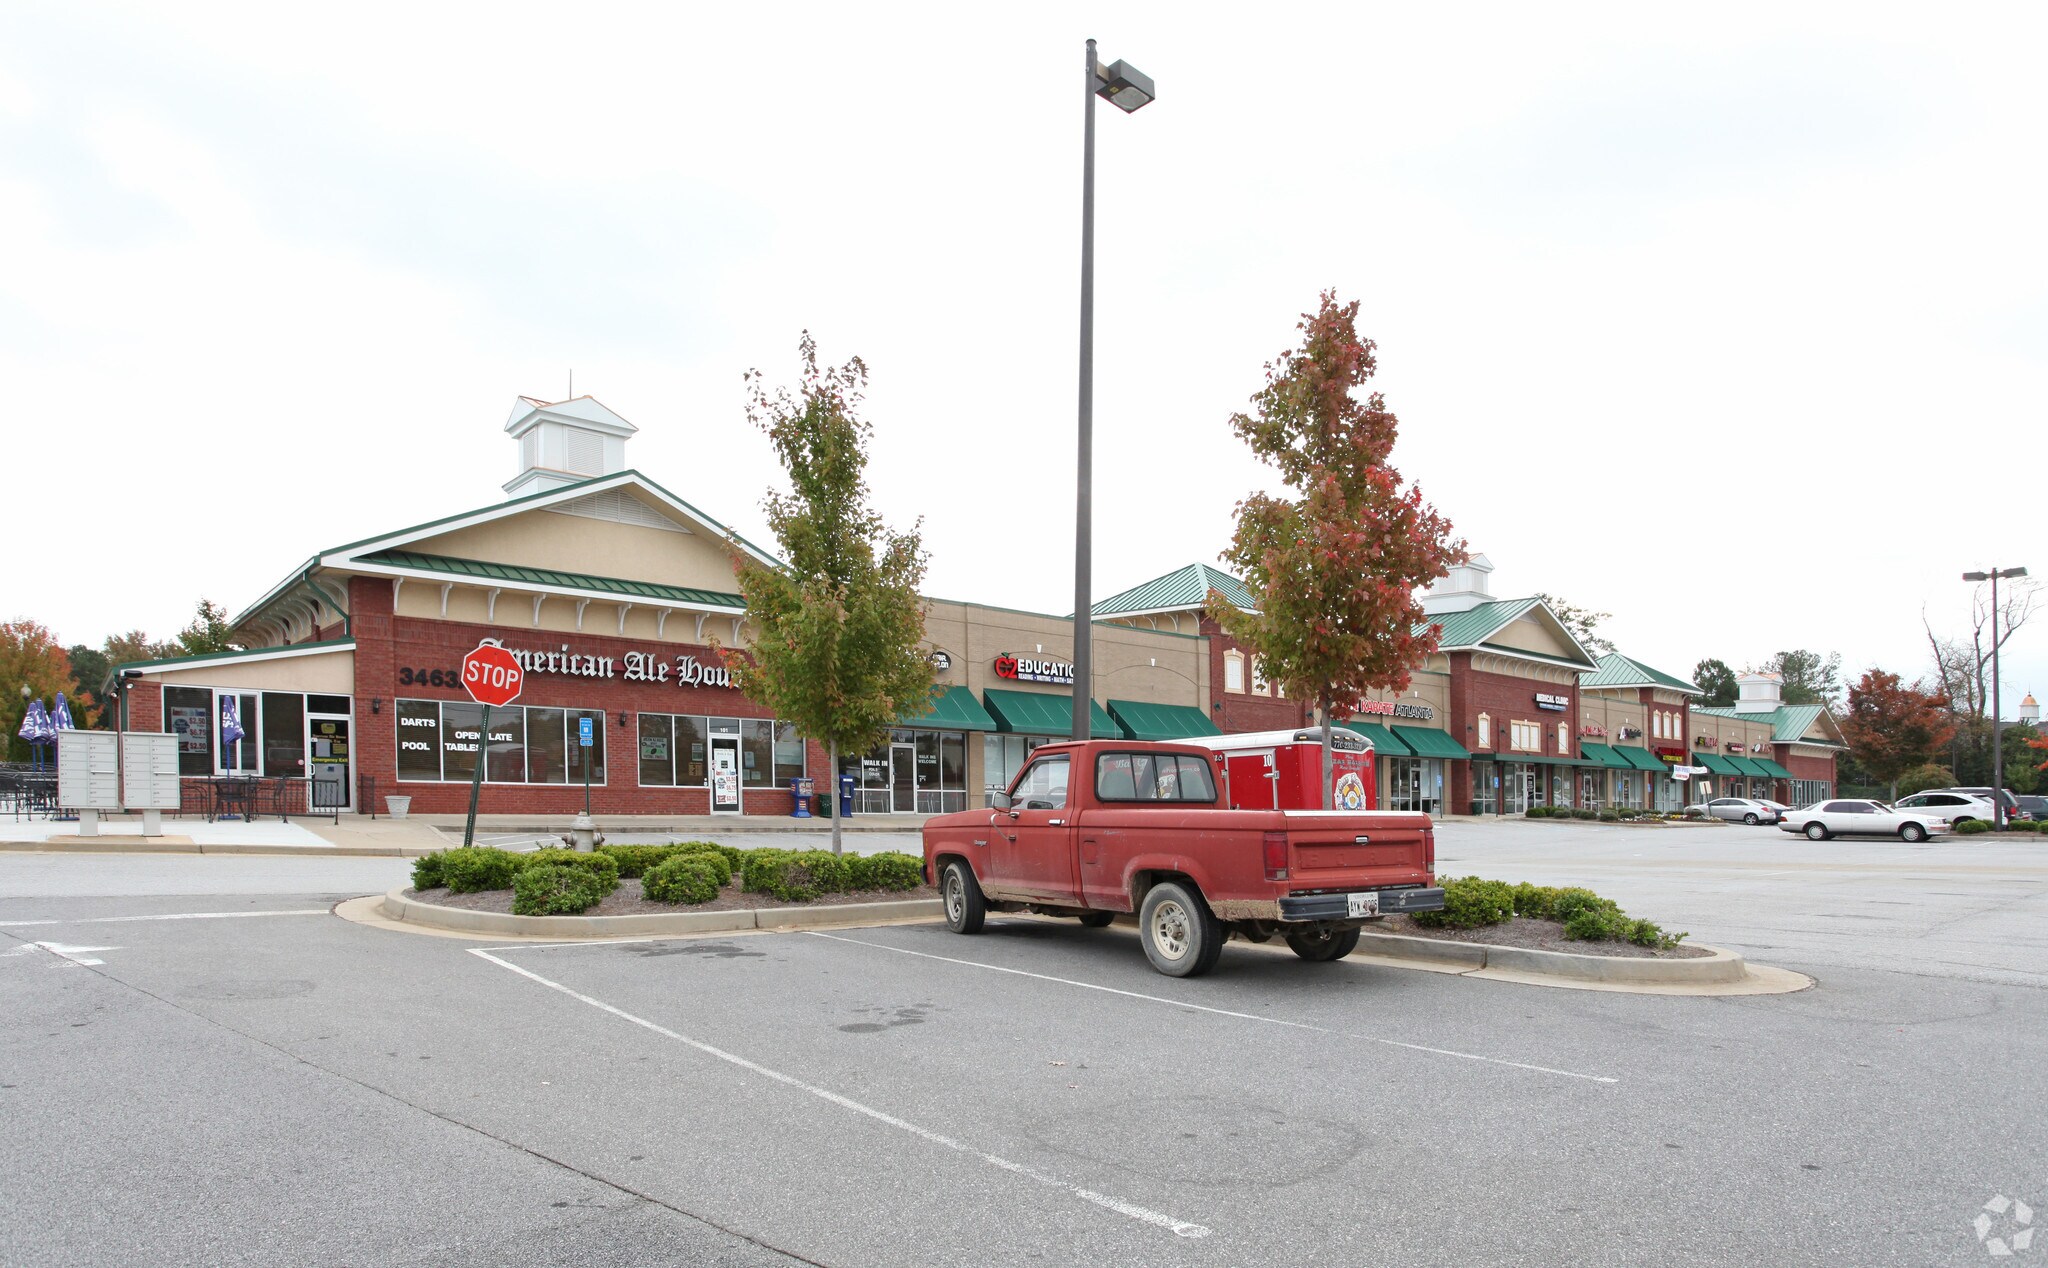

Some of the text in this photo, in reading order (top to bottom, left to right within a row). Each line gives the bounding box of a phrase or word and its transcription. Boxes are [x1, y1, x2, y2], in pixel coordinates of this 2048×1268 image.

[479, 637, 614, 679] merican
[623, 650, 669, 682] Ale
[466, 660, 518, 689] STOP
[1536, 693, 1569, 706] MEDICAL CLINIC
[1360, 699, 1395, 716] KARATE
[1395, 703, 1434, 720] ATLANTA
[401, 718, 436, 727] DARTS
[488, 733, 512, 741] LATE
[401, 741, 430, 750] POOL
[863, 759, 880, 767] WALK
[1263, 754, 1272, 767] 10
